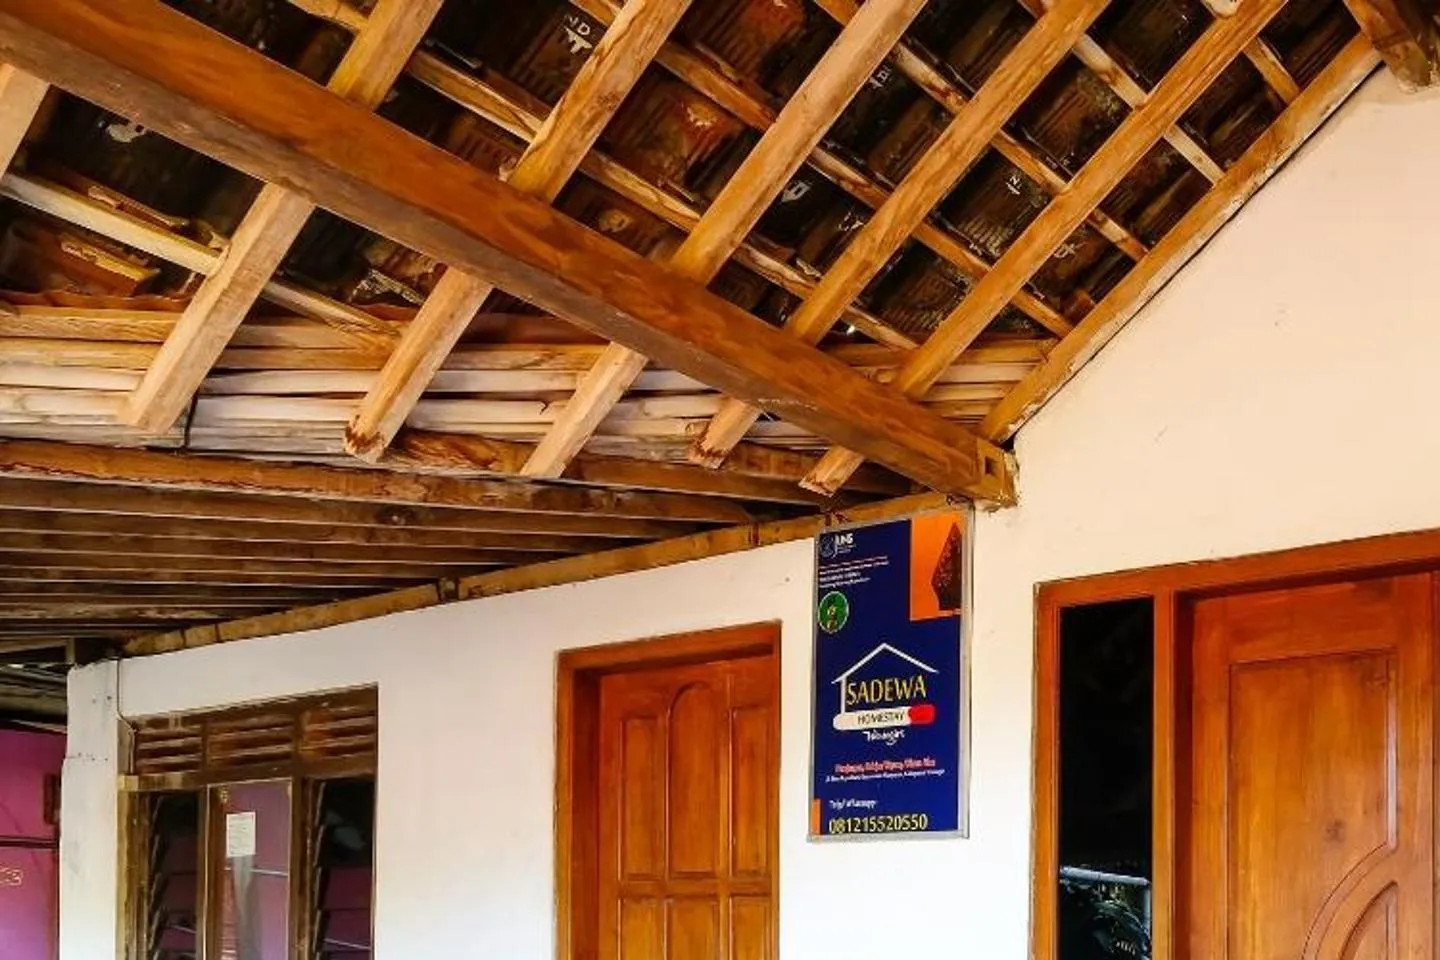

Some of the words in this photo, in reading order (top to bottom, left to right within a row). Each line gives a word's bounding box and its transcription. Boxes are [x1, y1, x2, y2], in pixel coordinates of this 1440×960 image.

[846, 675, 927, 705] SADEWA
[857, 711, 905, 725] HOMESTAY
[828, 813, 928, 834] 081215520550
